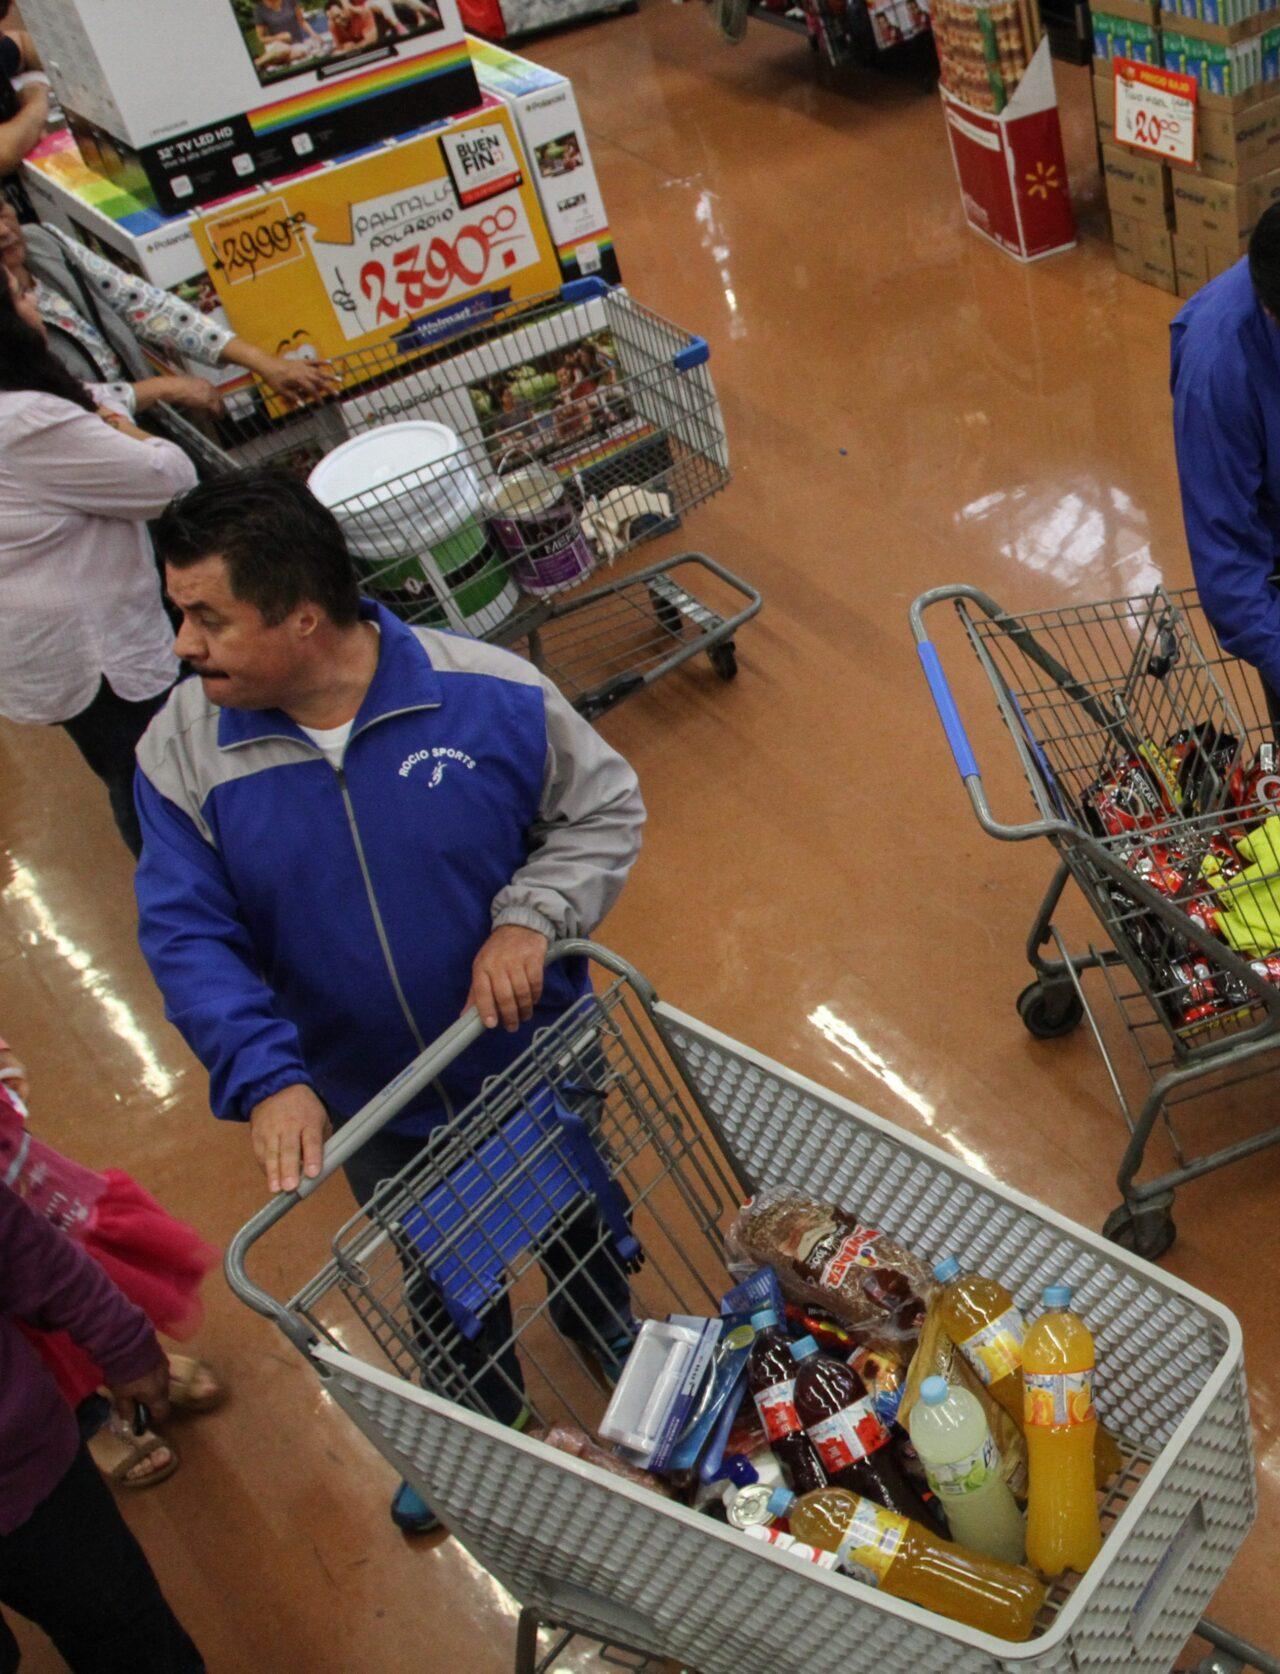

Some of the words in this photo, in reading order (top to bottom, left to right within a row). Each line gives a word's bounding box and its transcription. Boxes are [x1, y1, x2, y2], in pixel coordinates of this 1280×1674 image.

[176, 140, 193, 156] TV
[192, 132, 215, 149] LED
[215, 126, 234, 141] HD
[456, 135, 500, 159] BUEN
[370, 208, 454, 251] POLAROID
[417, 306, 472, 338] Walmart
[398, 749, 430, 778] ROCIO
[431, 747, 477, 770] SPORTS
